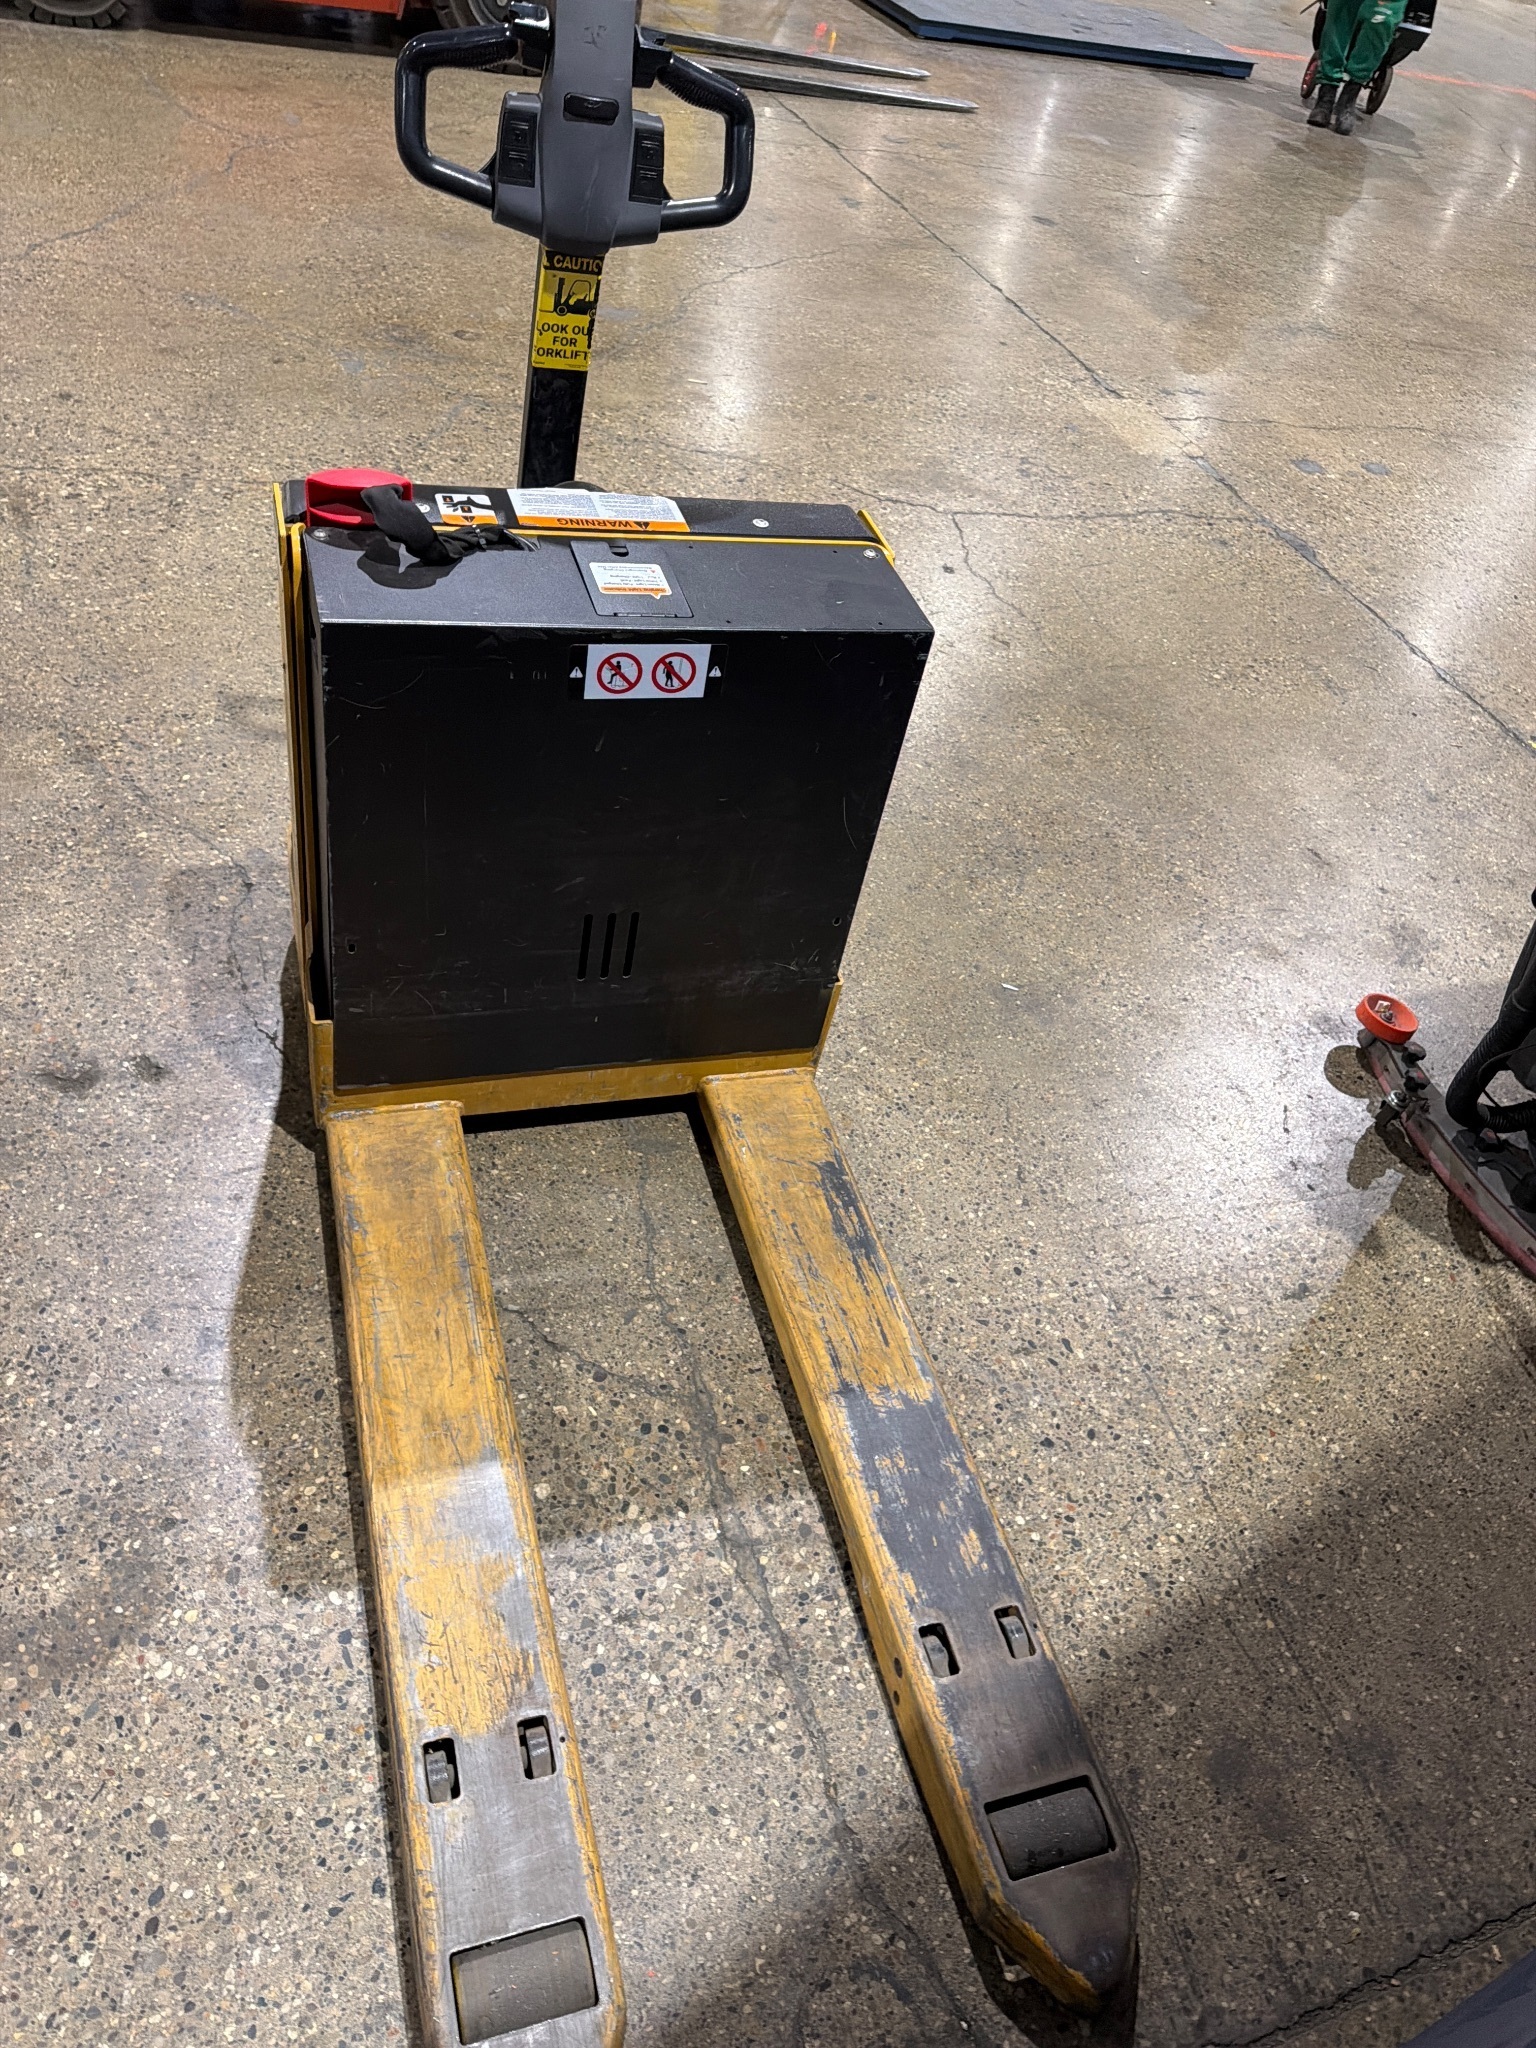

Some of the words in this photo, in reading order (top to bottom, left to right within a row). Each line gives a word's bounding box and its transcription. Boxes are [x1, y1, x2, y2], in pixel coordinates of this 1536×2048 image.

[553, 254, 603, 272] CAUTIO
[552, 336, 578, 348] FOR
[556, 517, 633, 529] WARNING
